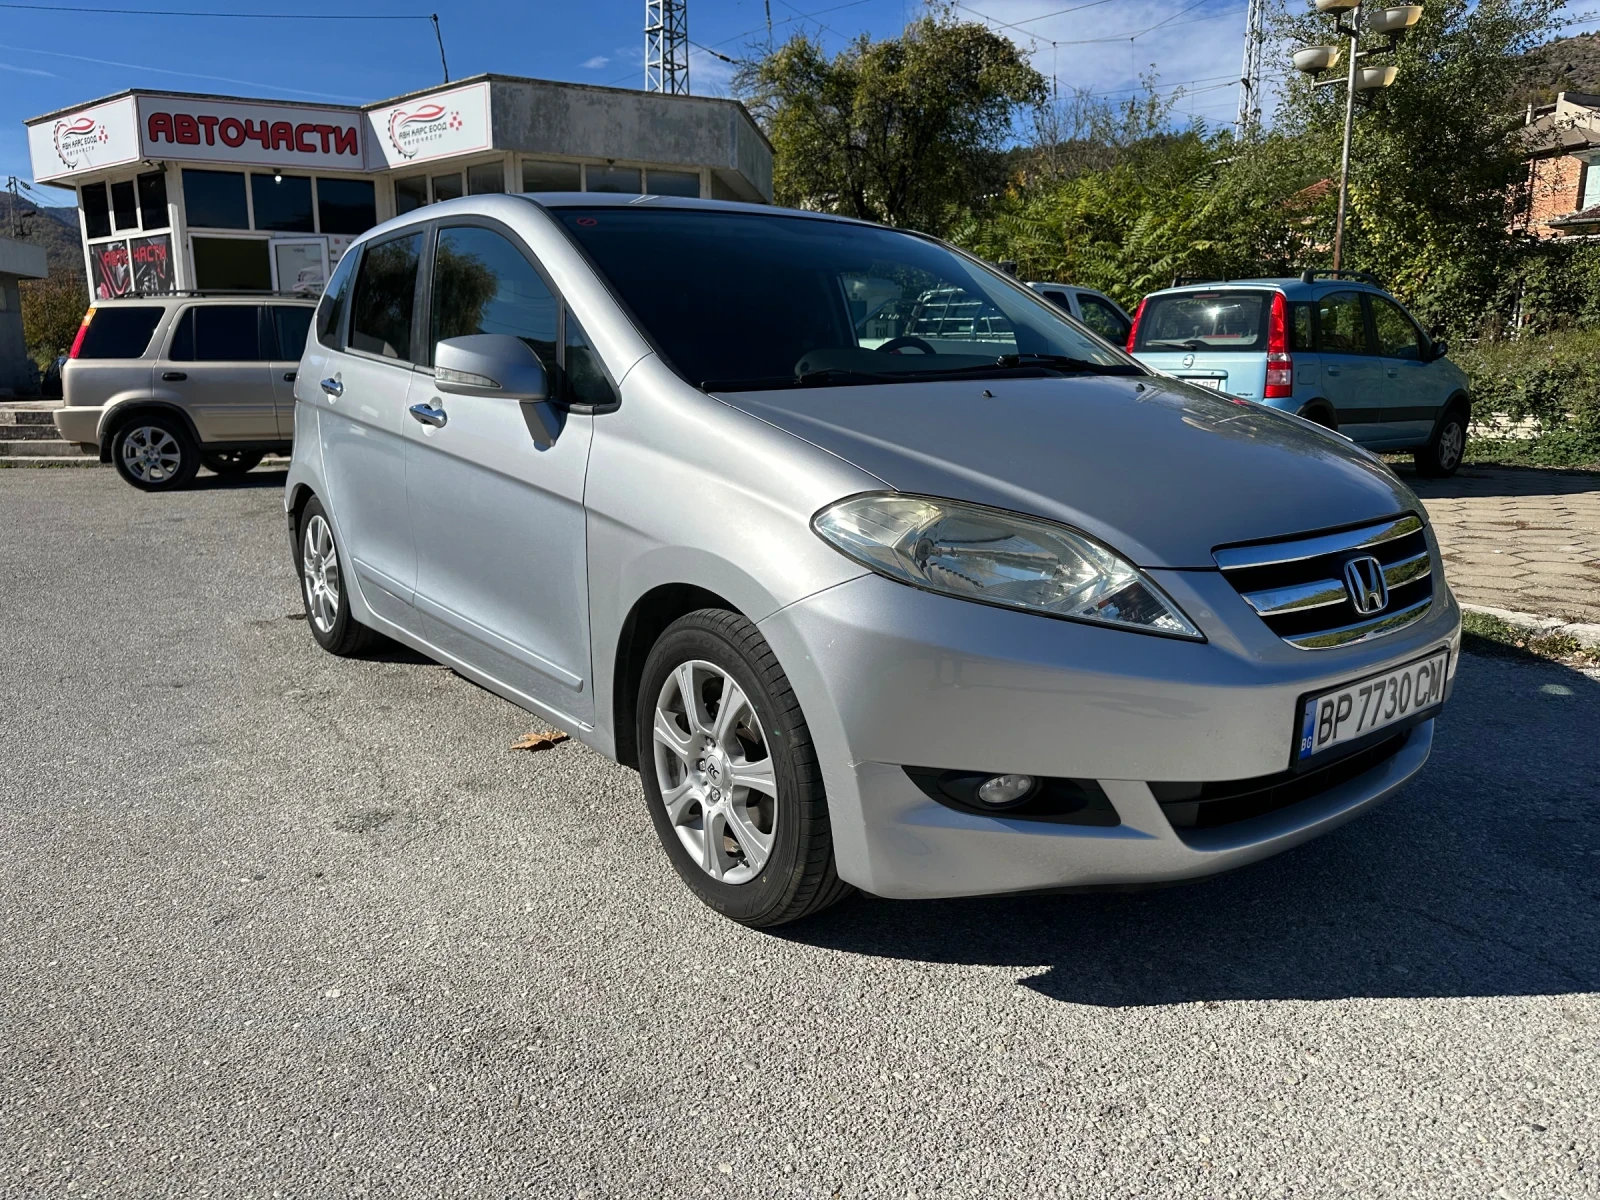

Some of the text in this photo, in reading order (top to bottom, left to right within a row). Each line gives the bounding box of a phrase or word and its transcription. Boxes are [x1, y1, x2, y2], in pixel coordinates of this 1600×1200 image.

[148, 112, 358, 156] АВТОЧАСТИ
[1356, 672, 1411, 732] 7730
[1415, 658, 1443, 708] CM
[1301, 736, 1313, 752] BG
